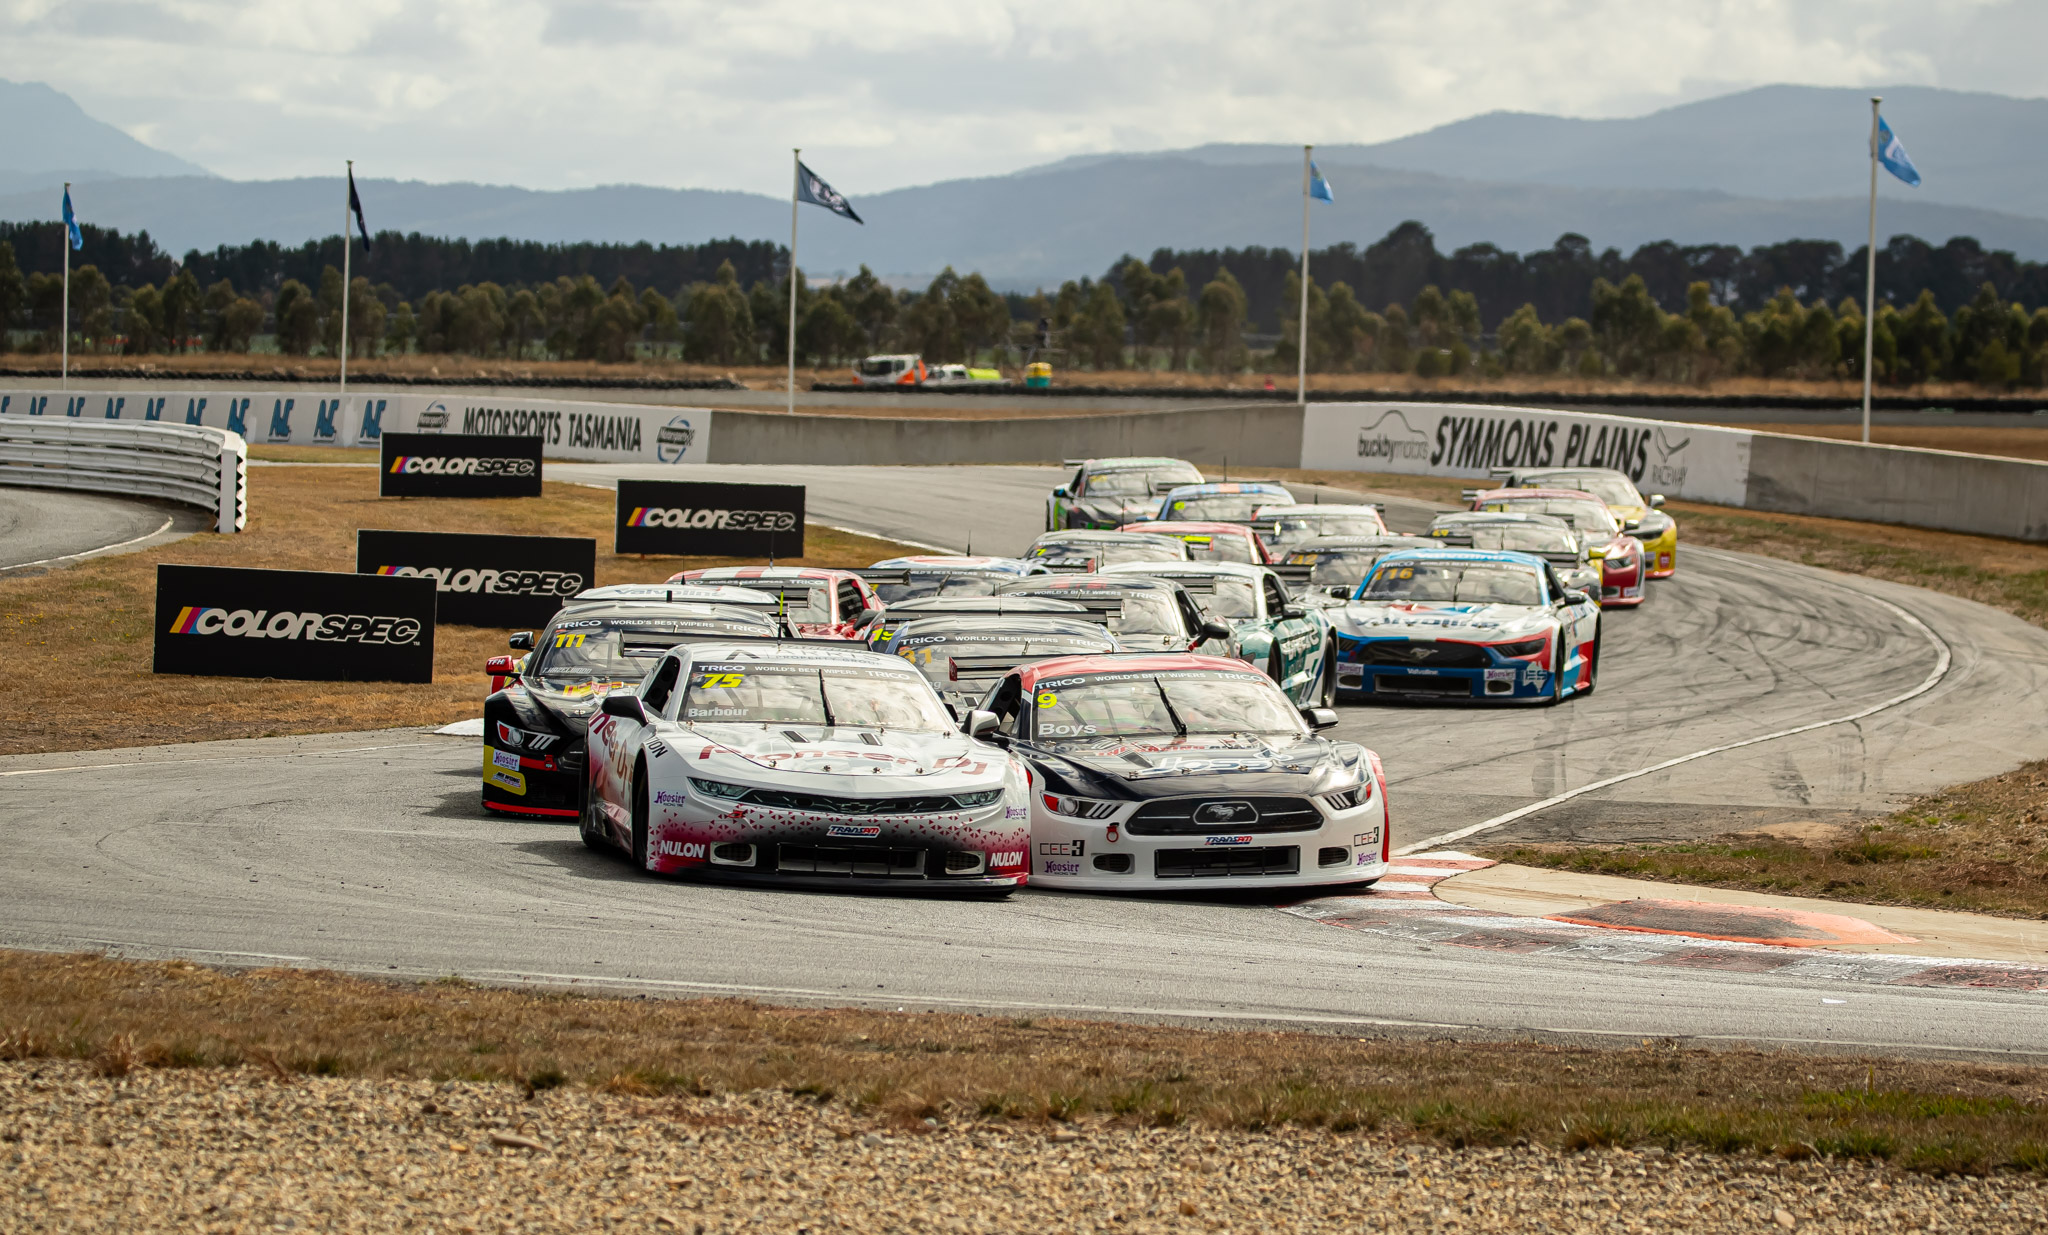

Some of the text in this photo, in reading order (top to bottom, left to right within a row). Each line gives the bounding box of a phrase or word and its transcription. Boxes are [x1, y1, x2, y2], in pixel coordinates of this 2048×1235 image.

[568, 413, 642, 452] TASMANIA
[1430, 415, 1652, 483] SYMMONS PLAINS
[404, 457, 535, 476] COLORSPEC
[643, 508, 797, 532] COLORSPEC
[1381, 560, 1414, 568] TRICO
[1218, 575, 1253, 583] TRICO
[1375, 567, 1414, 580] 116
[1128, 591, 1168, 600] TRICO
[196, 608, 421, 645] COLORSPEC
[555, 620, 602, 629] TRICO
[723, 623, 770, 634] TRICO
[555, 633, 586, 648] 111
[901, 635, 946, 646] TRICO
[1066, 638, 1110, 649] TRICO
[487, 658, 506, 666] TFH
[823, 668, 858, 676] WIPERS
[864, 670, 911, 680] TRICO
[1406, 668, 1439, 676] Valvoline
[1486, 669, 1515, 680] Hoosier
[700, 673, 745, 689] 75
[1036, 677, 1086, 690] TRICO
[1094, 674, 1139, 682] WORLD'S
[1214, 672, 1264, 682] TRICO
[1037, 693, 1058, 709] 9
[688, 706, 749, 718] Barbour
[1038, 723, 1098, 736] Boys
[698, 744, 918, 764] Pioneer
[654, 791, 686, 804] Hoosier
[659, 839, 706, 858] NULON
[990, 851, 1024, 867] NULON
[1044, 860, 1080, 873] Hoosier
